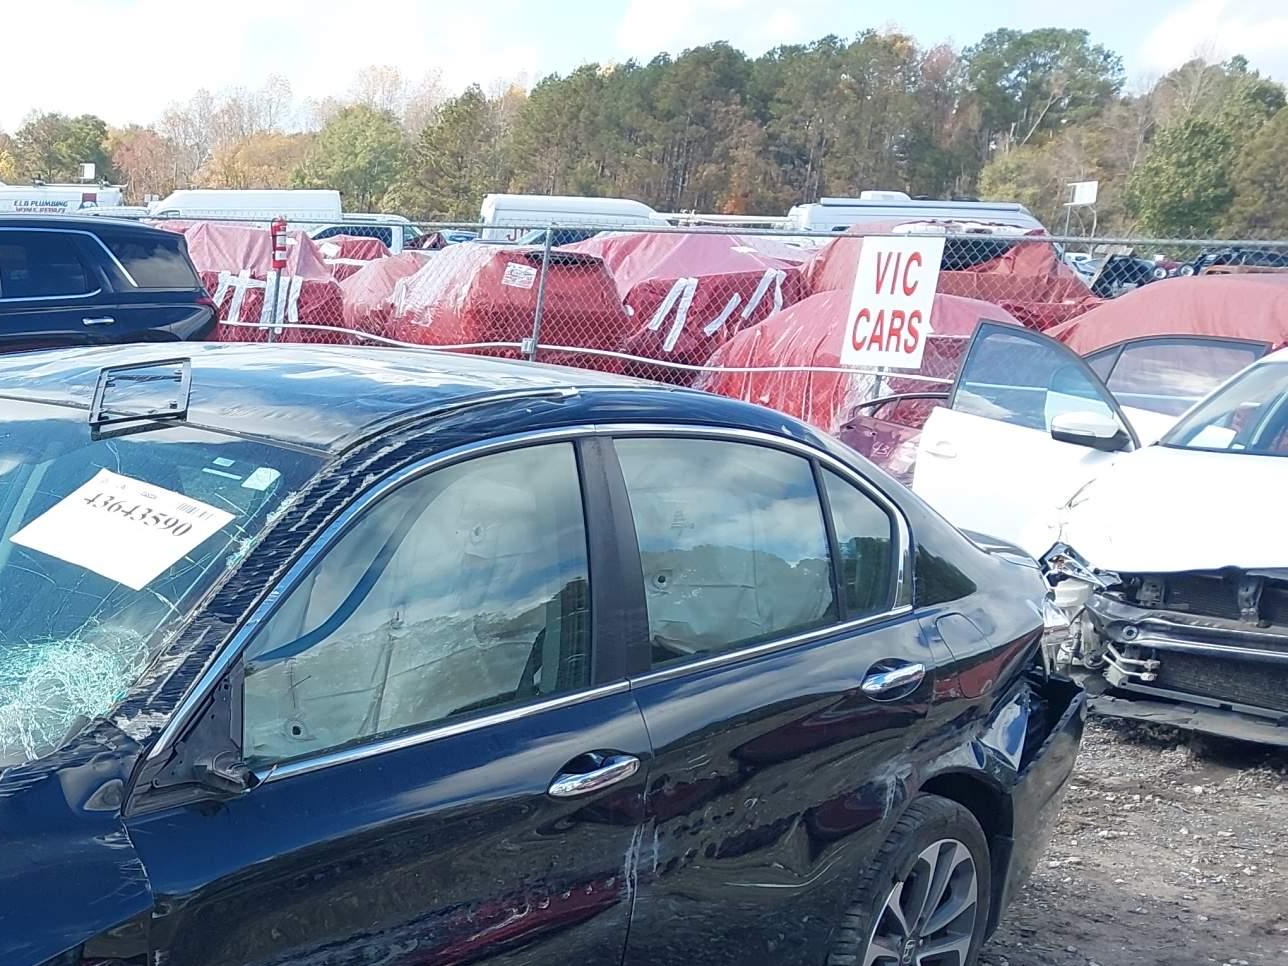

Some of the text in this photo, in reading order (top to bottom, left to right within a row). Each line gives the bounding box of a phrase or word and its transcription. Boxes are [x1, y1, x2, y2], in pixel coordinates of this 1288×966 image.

[875, 251, 922, 296] VIC
[852, 308, 922, 353] CARS
[83, 492, 193, 537] 43643590
